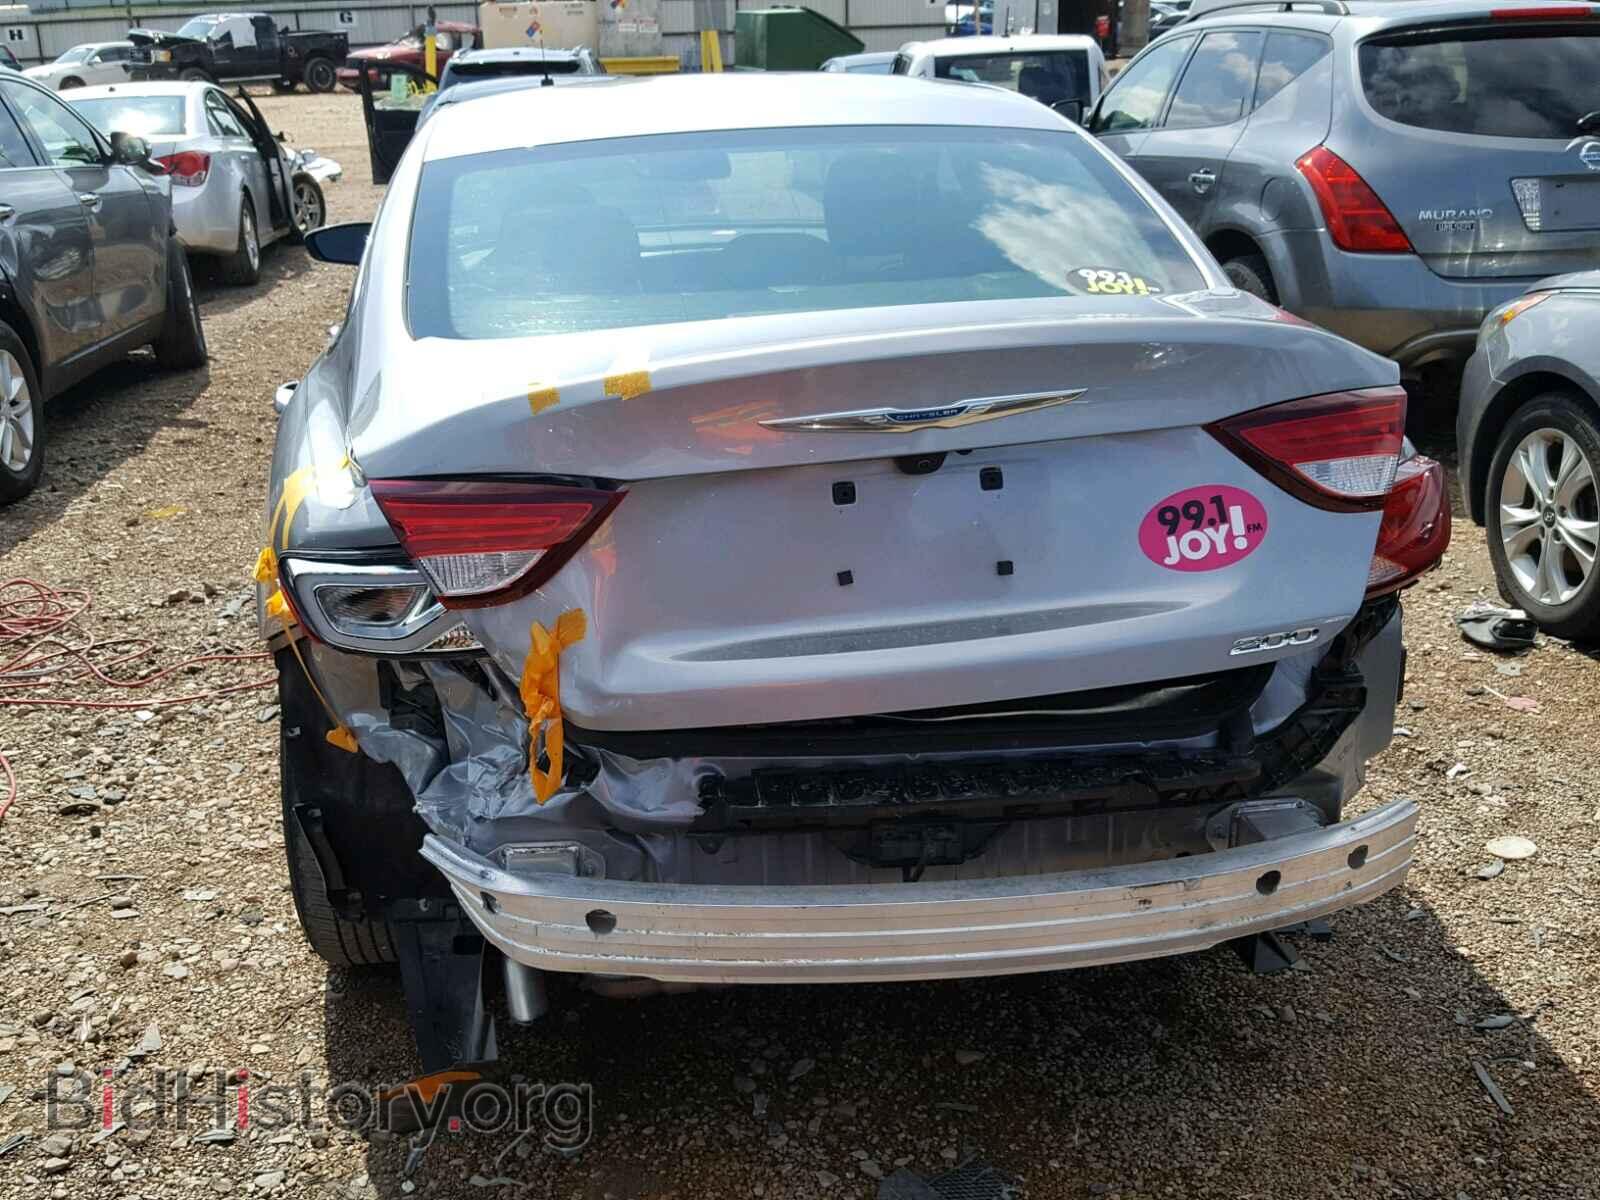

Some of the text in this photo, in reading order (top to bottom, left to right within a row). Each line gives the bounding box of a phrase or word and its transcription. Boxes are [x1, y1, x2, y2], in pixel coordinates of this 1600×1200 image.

[340, 11, 353, 24] G
[9, 29, 24, 41] H
[1418, 208, 1493, 221] MURANO
[1158, 495, 1228, 535] 99.1
[1164, 505, 1263, 565] JOY! FM
[1230, 626, 1319, 656] 200
